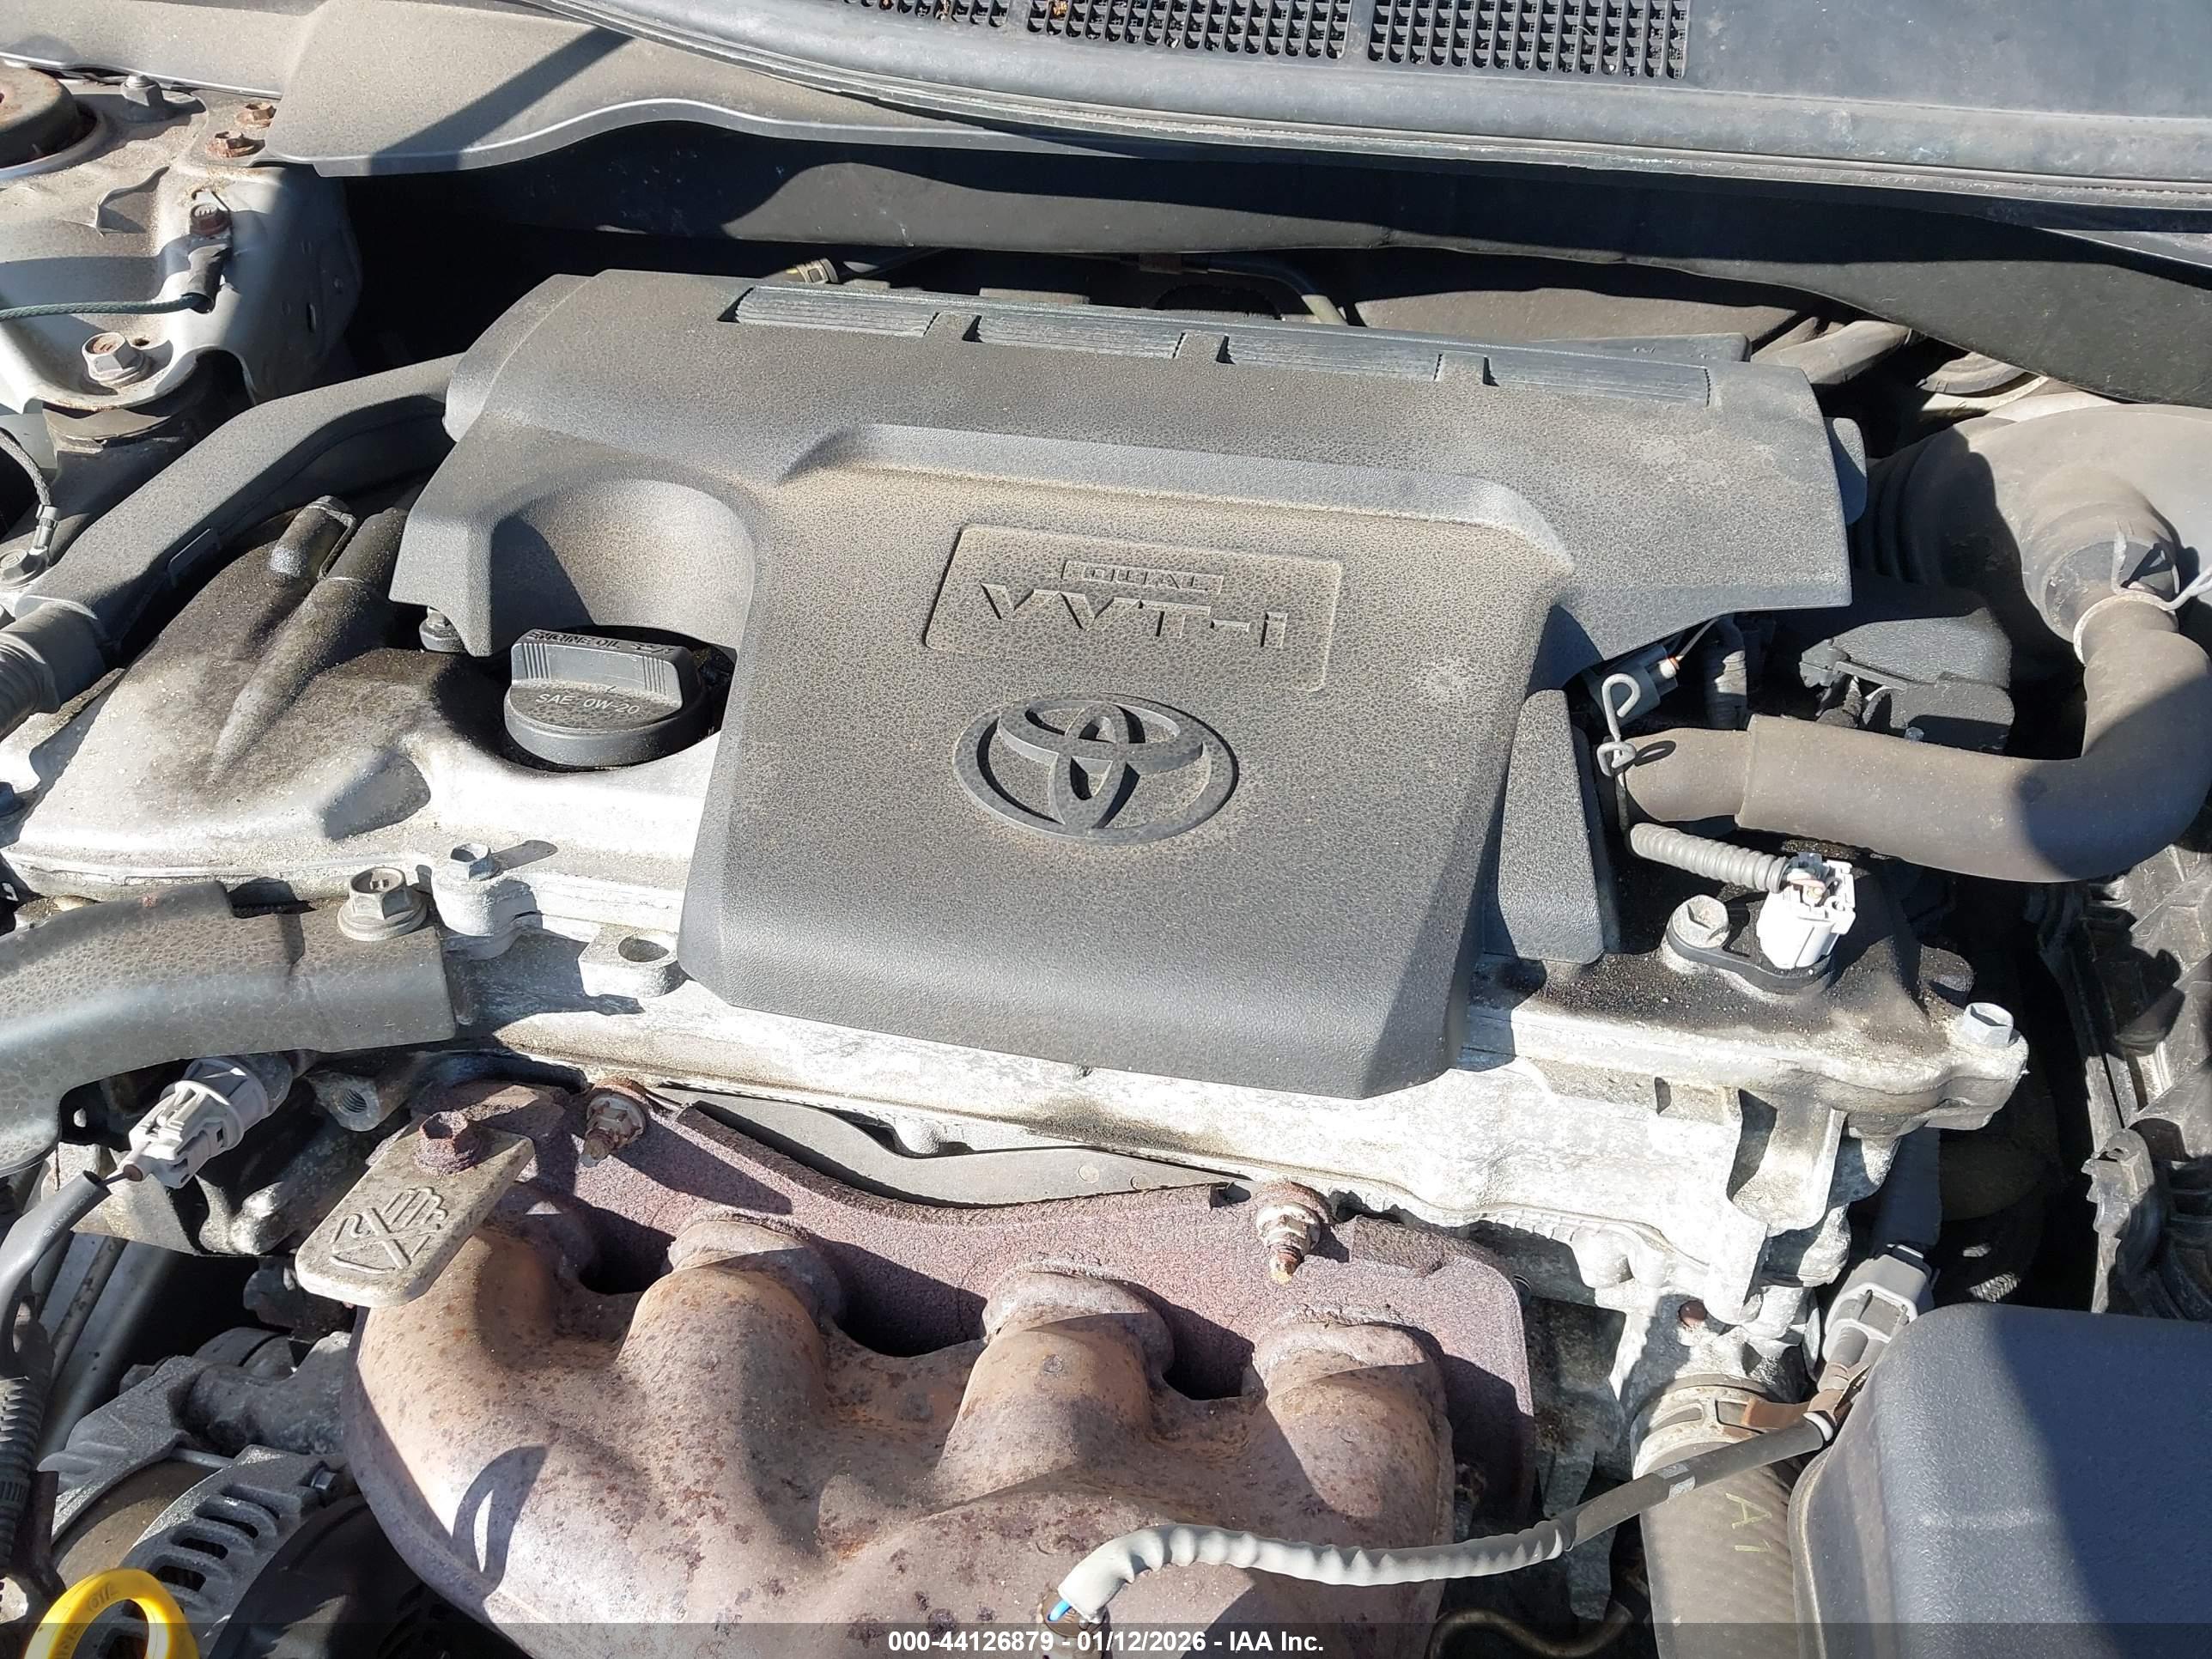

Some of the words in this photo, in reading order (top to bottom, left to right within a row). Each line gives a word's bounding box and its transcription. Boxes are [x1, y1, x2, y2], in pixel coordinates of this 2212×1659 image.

[1083, 565, 1208, 592] DUAL
[526, 631, 596, 645] ENGINE
[596, 639, 621, 650] OIL
[535, 693, 576, 706] SAE
[582, 697, 641, 715] 0W-20
[88, 1584, 118, 1612] OIL
